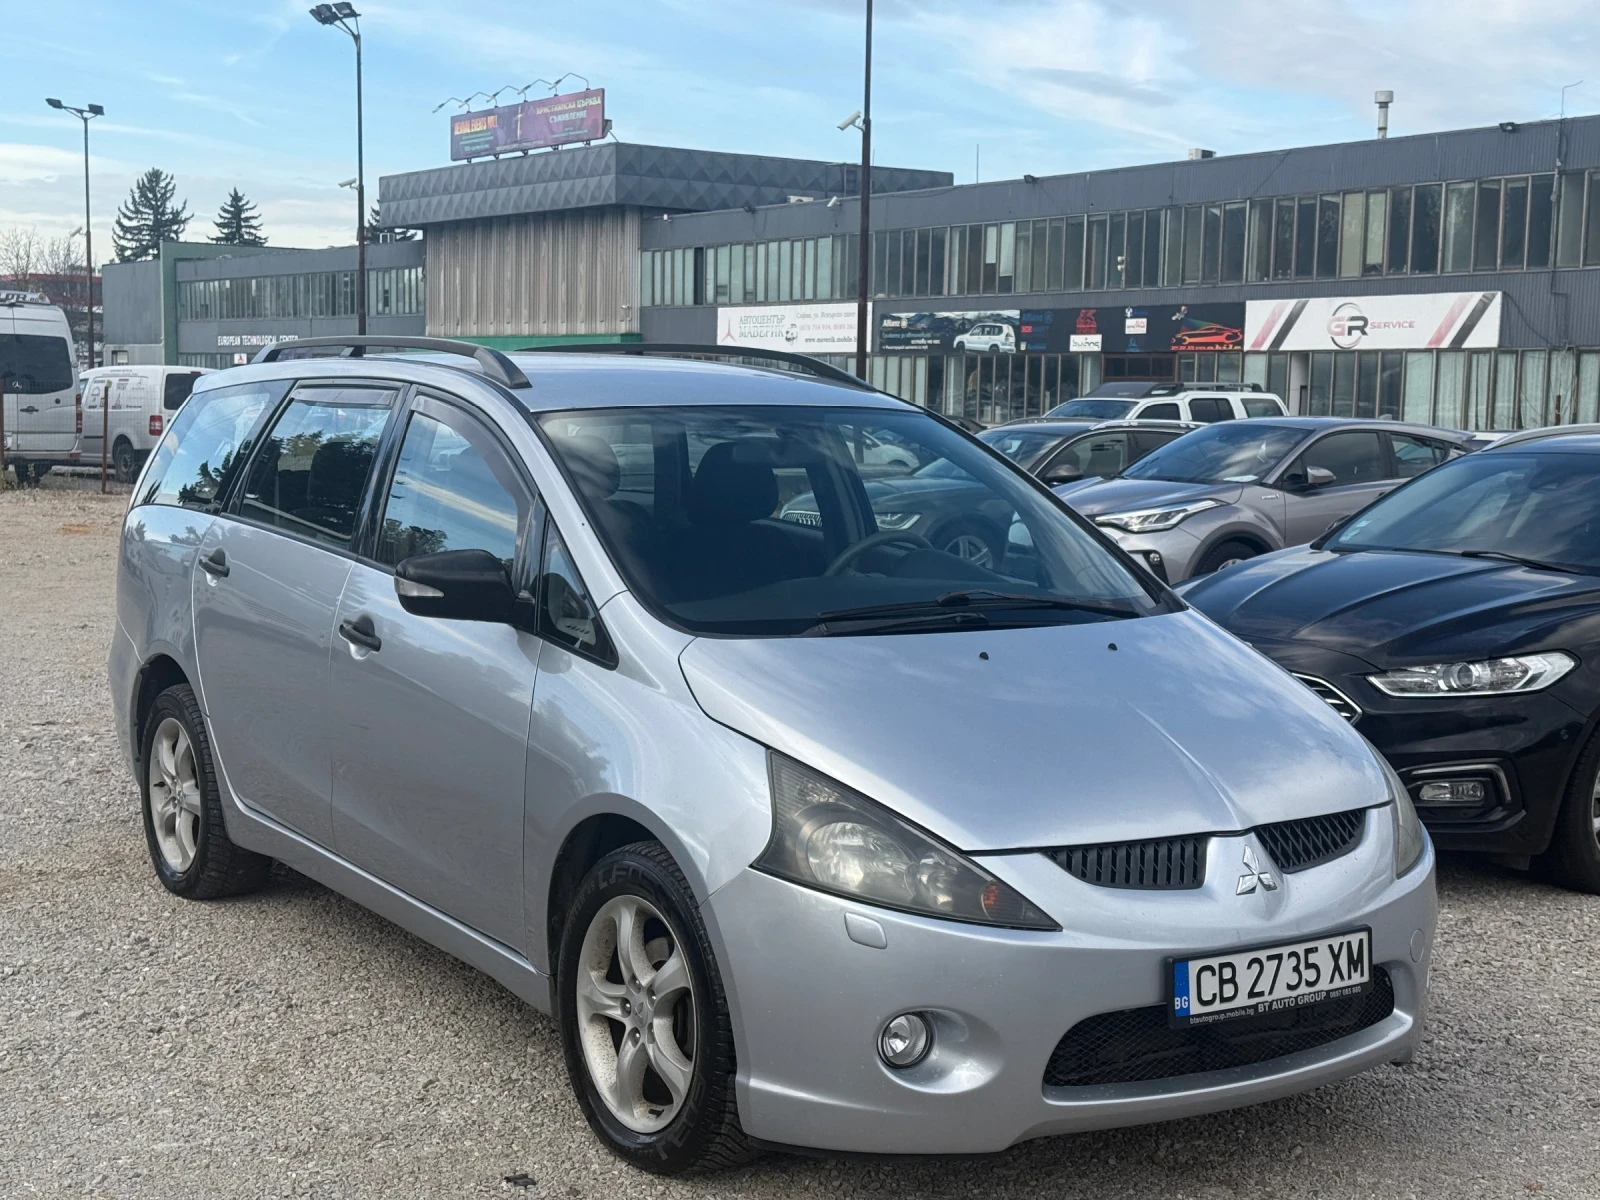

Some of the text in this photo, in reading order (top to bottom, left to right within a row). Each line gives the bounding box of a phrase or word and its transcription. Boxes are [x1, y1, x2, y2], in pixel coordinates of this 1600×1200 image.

[738, 314, 786, 324] АВТОЦЕНТЪР
[1327, 316, 1415, 336] GR SERVICE
[738, 325, 784, 338] МАВЕРИК
[217, 335, 241, 346] EUROPEAN
[242, 335, 277, 346] TECHNOLOGICAL
[1196, 938, 1365, 1006] CB 2735 XM
[1174, 996, 1188, 1010] BG
[1190, 1008, 1254, 1024] btautogroup.mobile.bg
[1258, 1001, 1270, 1012] BT
[1272, 997, 1296, 1010] AUTO
[1298, 992, 1326, 1005] GROUP
